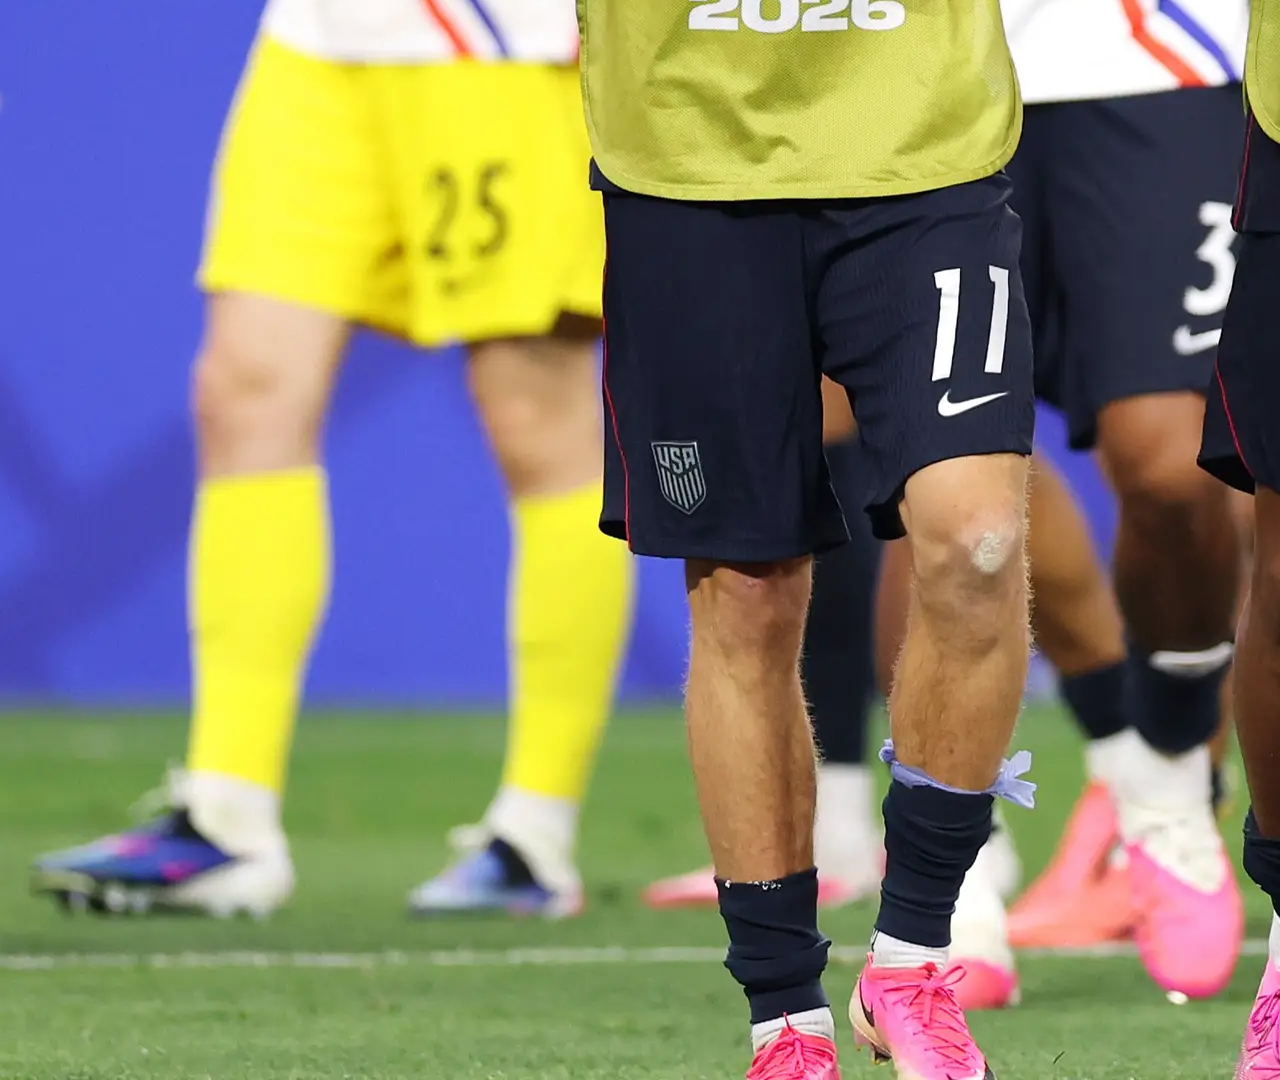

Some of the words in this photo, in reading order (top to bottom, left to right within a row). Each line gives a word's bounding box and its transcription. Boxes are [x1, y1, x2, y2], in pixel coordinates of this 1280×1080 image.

[425, 160, 515, 261] 25
[1183, 200, 1237, 316] 3
[931, 265, 1009, 381] 11
[655, 446, 696, 474] USA
